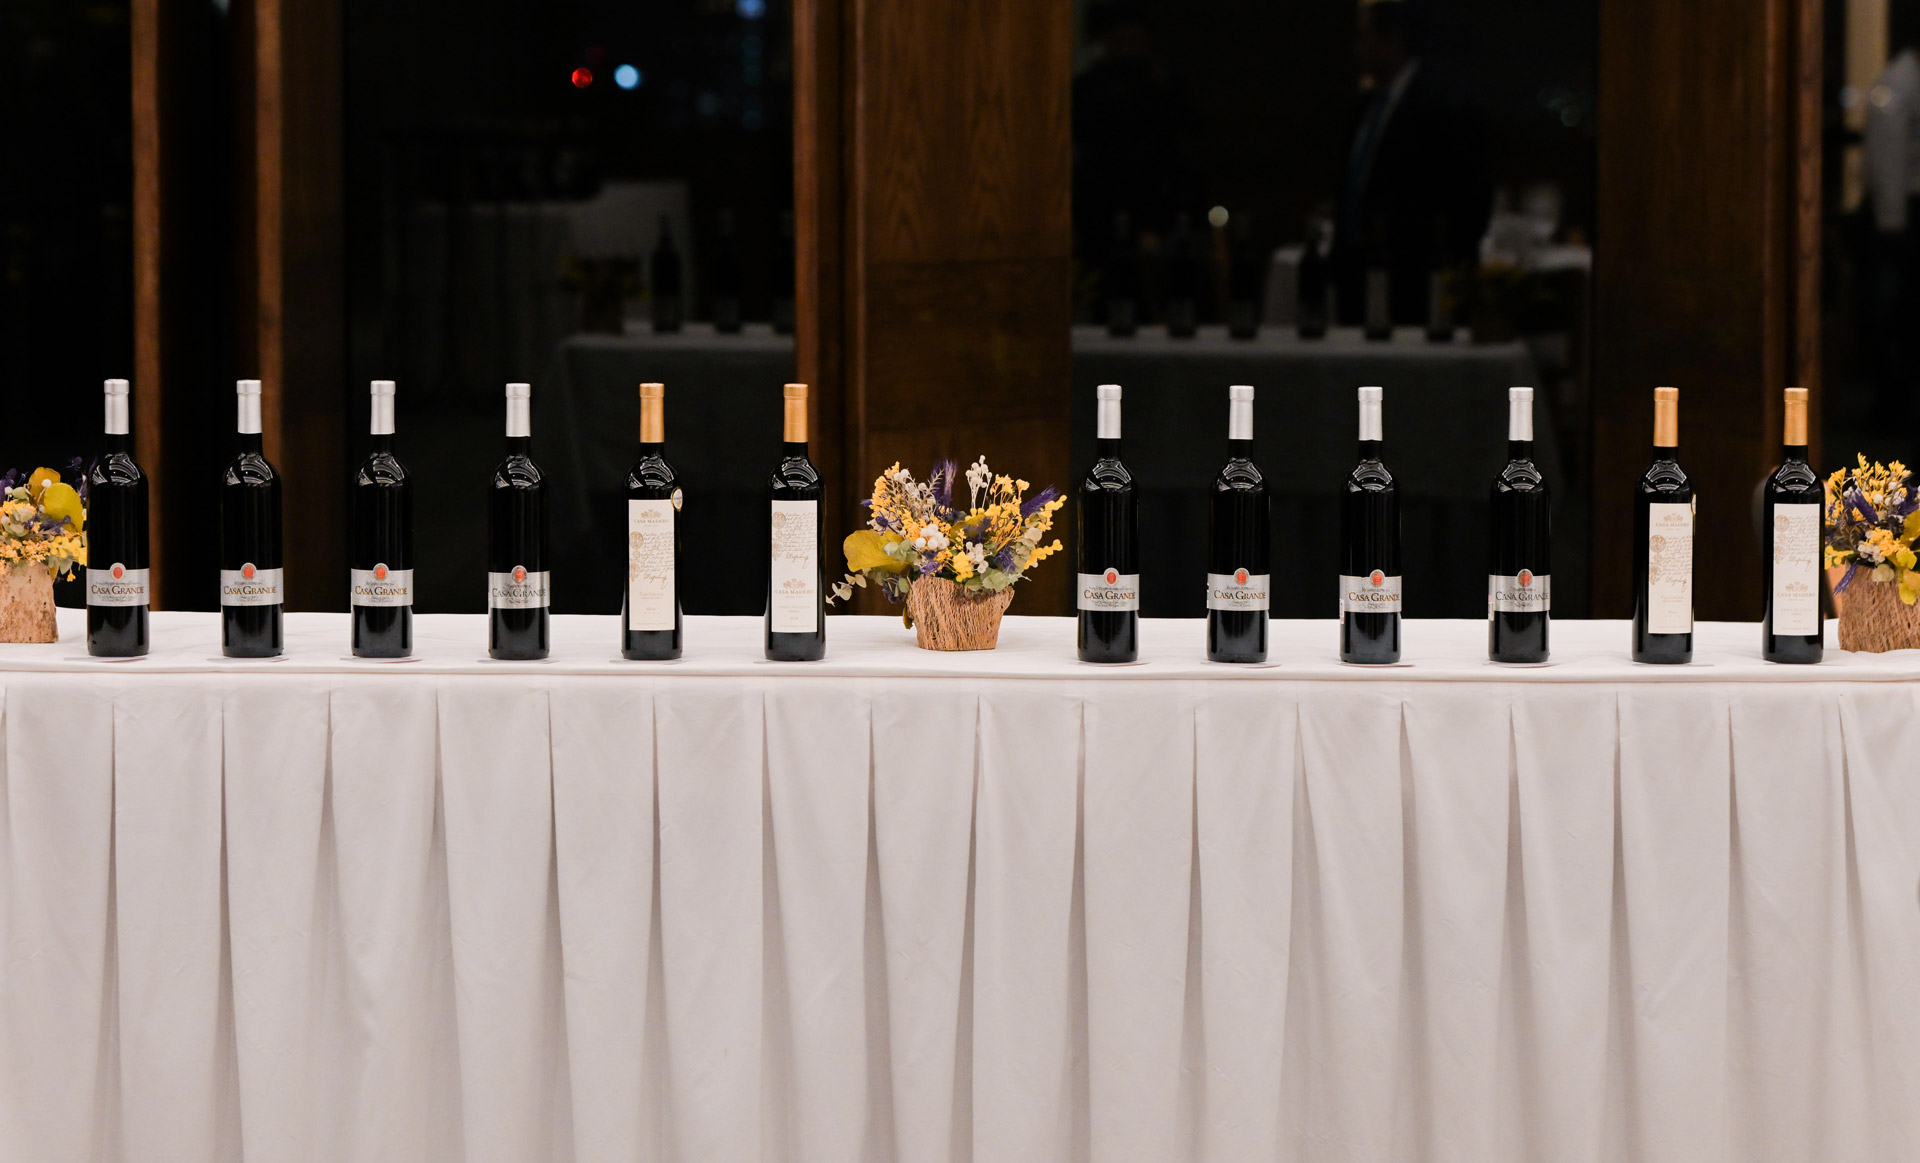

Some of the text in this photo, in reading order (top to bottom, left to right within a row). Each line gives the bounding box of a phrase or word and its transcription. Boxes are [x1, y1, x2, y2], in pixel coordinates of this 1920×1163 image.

[91, 585, 144, 595] CASA GRANDE
[223, 586, 276, 595] CASA GRANDE
[355, 586, 408, 595] CASA GRANDE
[492, 588, 546, 597] CASA GRANDE
[1084, 590, 1136, 599] CASA GRANDE
[1213, 590, 1266, 599] CASA GRANDE
[1348, 592, 1400, 601] CASA GRANDE
[1495, 591, 1550, 601] CASA GRANDE
